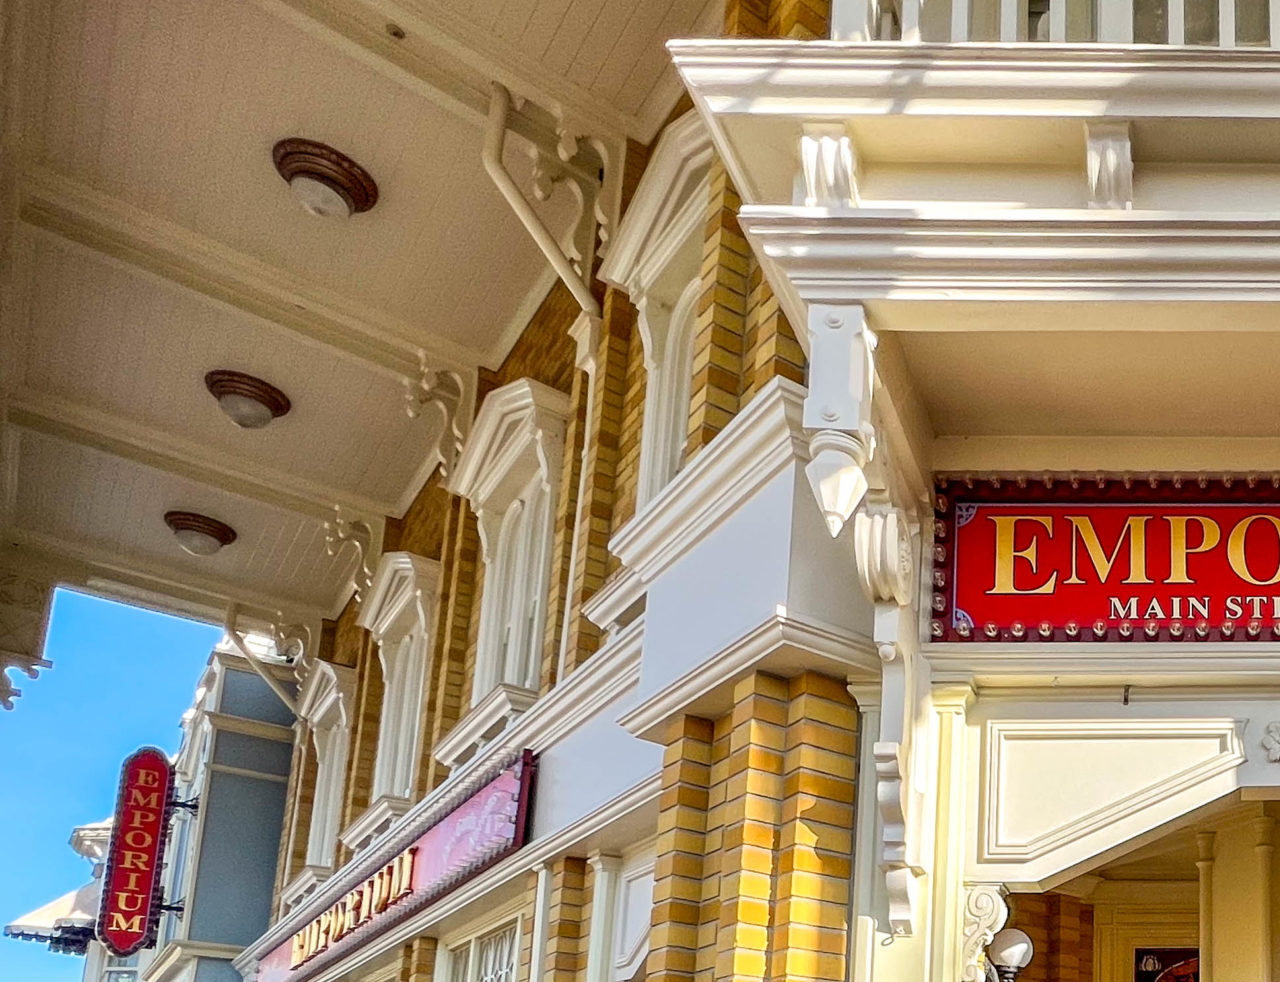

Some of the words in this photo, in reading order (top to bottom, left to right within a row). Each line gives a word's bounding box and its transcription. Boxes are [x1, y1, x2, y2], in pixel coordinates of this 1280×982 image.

[1108, 596, 1211, 620] MAIN
[107, 767, 161, 934] EMPORIUM
[289, 846, 419, 971] EMPORIUM
